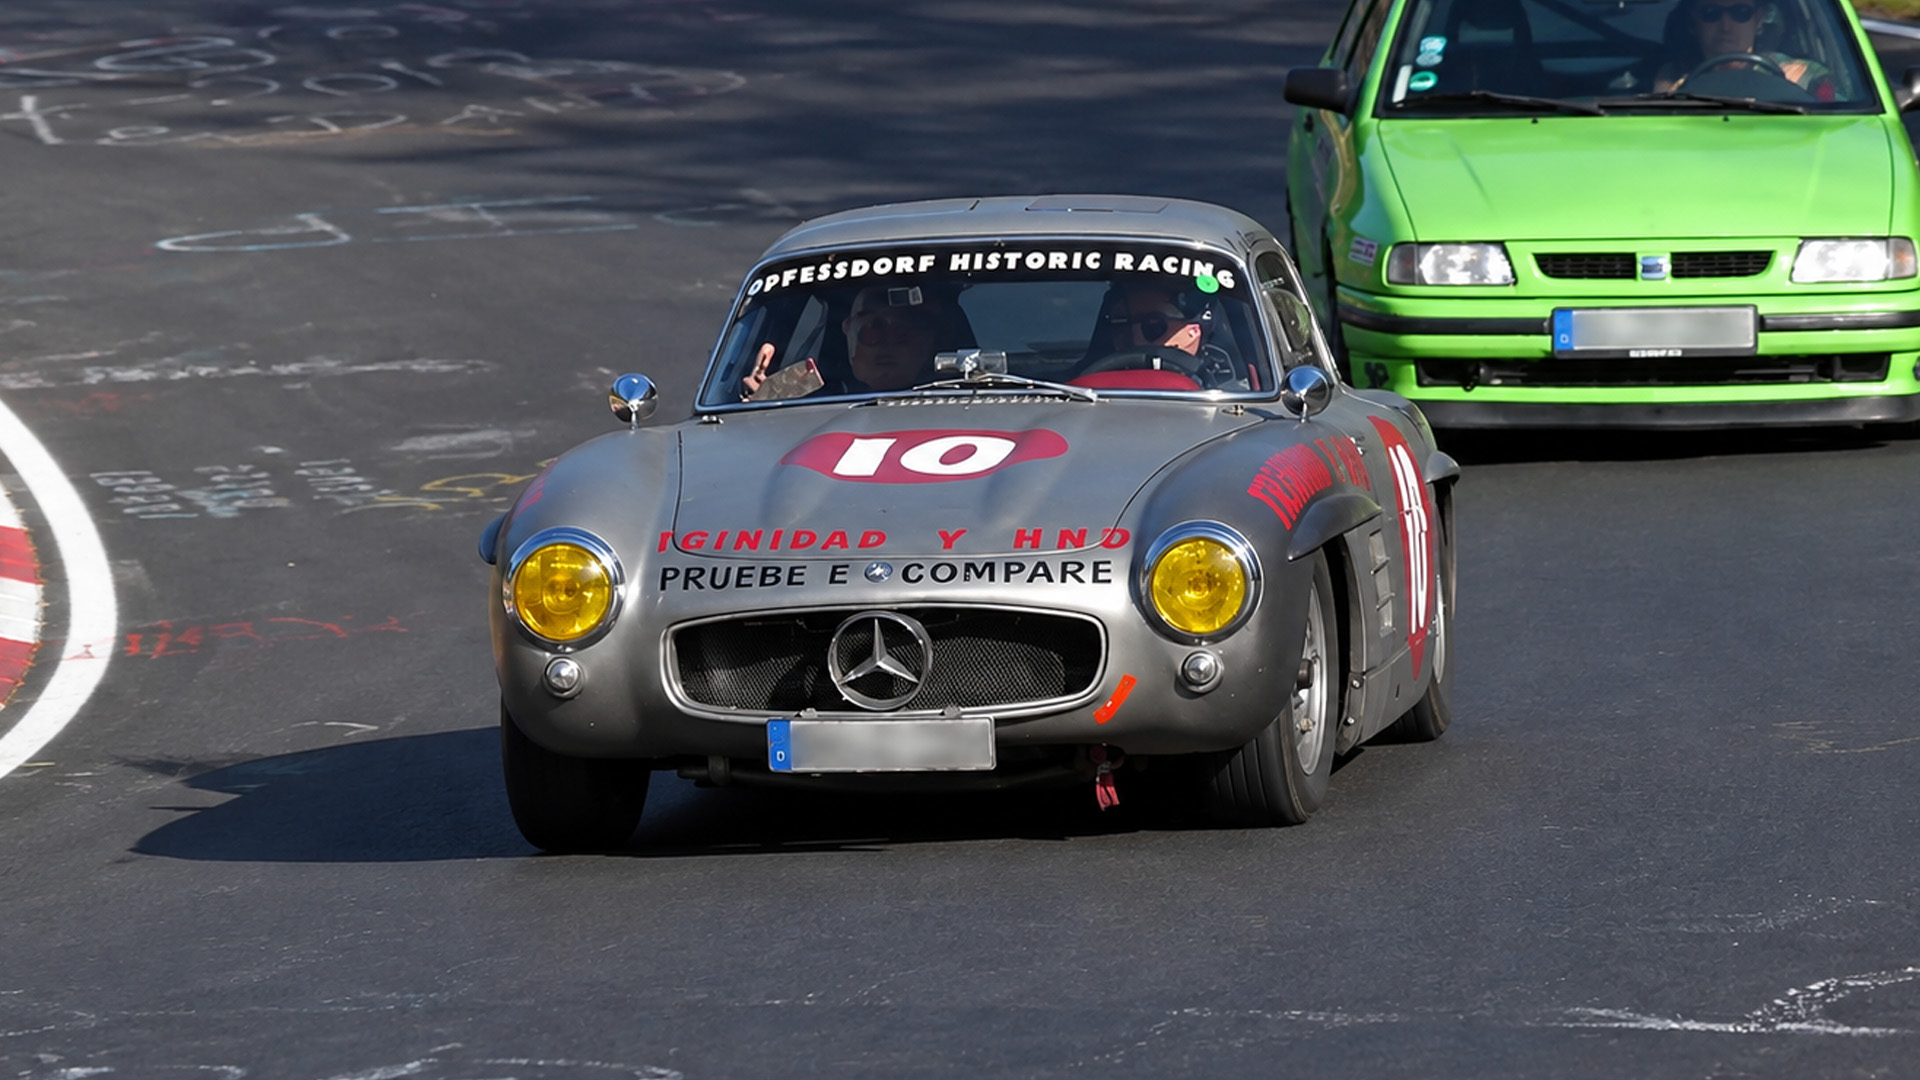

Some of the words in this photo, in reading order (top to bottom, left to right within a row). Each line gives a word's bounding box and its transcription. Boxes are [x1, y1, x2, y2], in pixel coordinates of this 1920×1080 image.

[950, 252, 1101, 271] HISTORIC
[1114, 253, 1235, 289] RACING
[832, 435, 1017, 476] 10
[937, 528, 968, 550] Y
[660, 565, 808, 591] PRUEBE
[828, 564, 850, 585] E
[901, 560, 1113, 584] COMPARE
